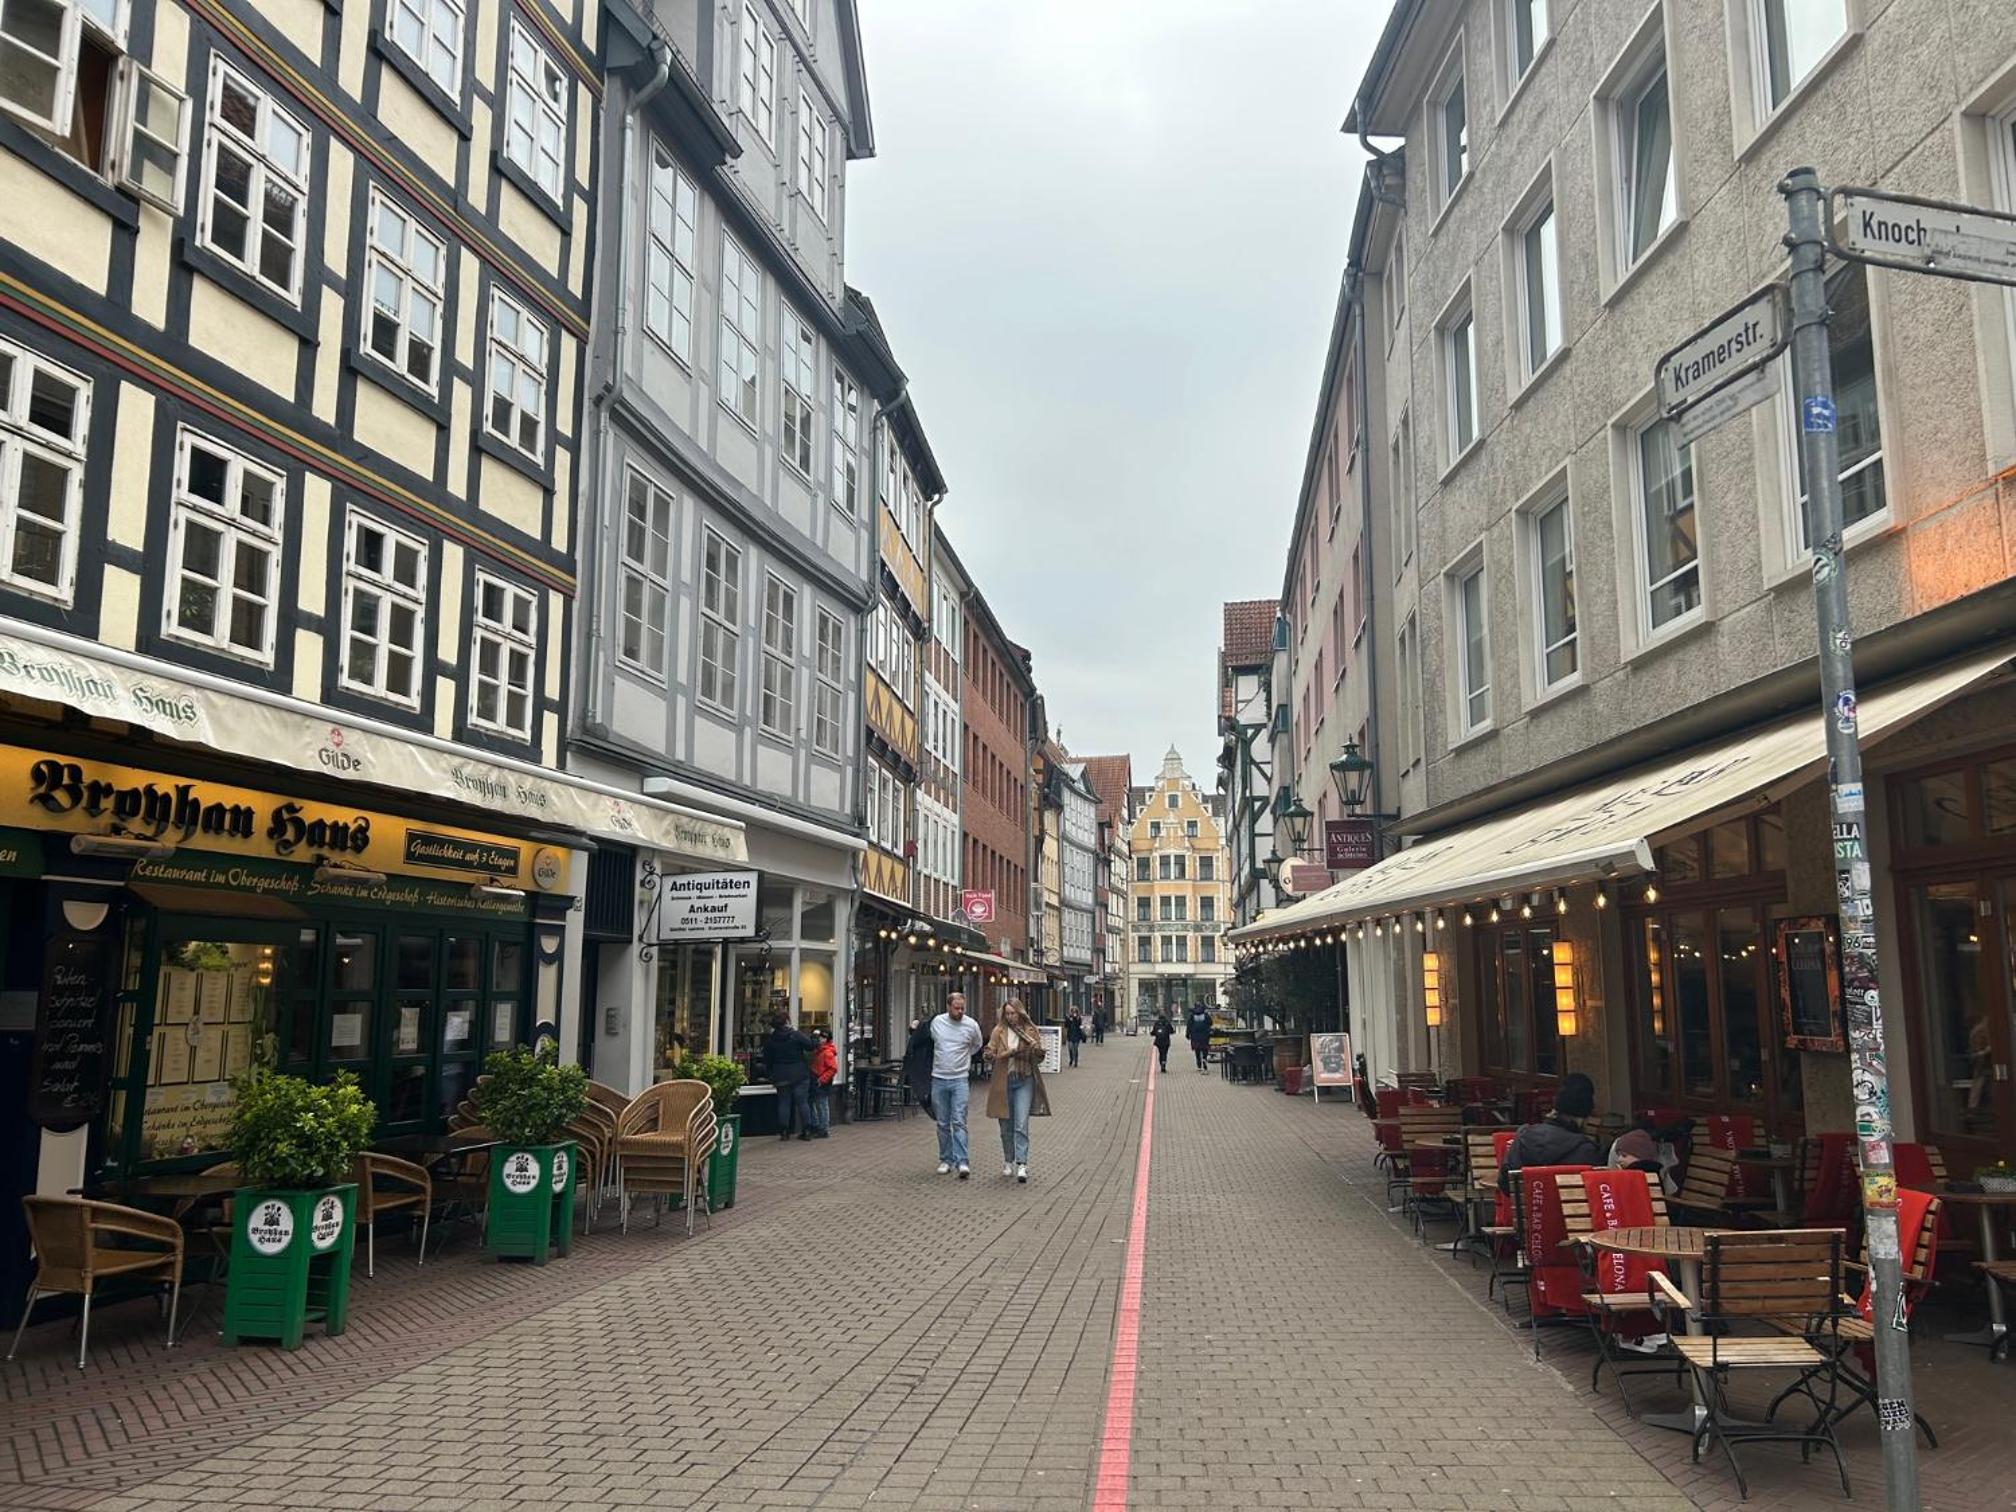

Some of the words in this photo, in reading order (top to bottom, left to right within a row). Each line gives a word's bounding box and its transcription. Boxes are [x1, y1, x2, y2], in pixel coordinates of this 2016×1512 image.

[1861, 209, 1927, 246] Knoch
[1673, 320, 1763, 393] Kramerstr.
[132, 686, 197, 722] Haus
[318, 747, 361, 772] Gilde
[29, 760, 256, 843] Broyhan
[267, 801, 371, 856] Haus
[515, 785, 547, 806] Haus
[1330, 833, 1372, 843] ANTIQUES
[0, 848, 17, 863] en
[410, 839, 464, 860] Gastlichkeit
[464, 848, 480, 866] auf
[481, 852, 487, 863] 3
[488, 850, 516, 870] Etagen
[131, 857, 207, 882] Restaurant
[209, 869, 226, 884] im
[538, 866, 556, 879] Gilde
[670, 877, 751, 893] Antiquitäten
[688, 903, 728, 914] Ankauf
[681, 917, 698, 926] 0511
[1600, 1183, 1615, 1211] CAFE
[1612, 1252, 1626, 1292] ELONA
